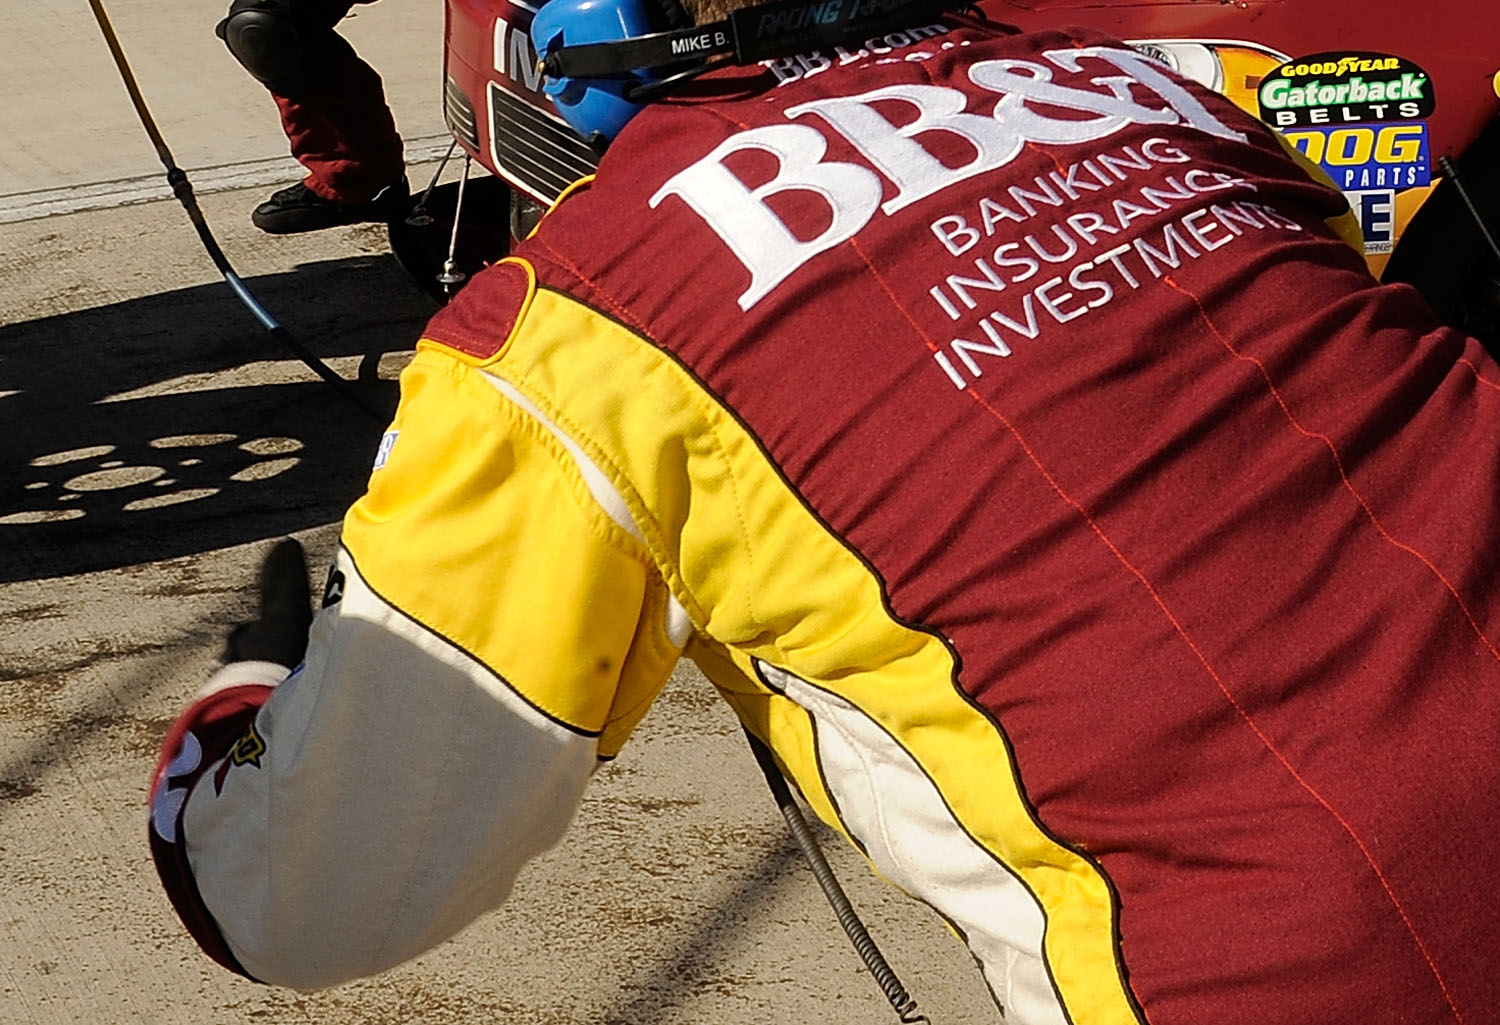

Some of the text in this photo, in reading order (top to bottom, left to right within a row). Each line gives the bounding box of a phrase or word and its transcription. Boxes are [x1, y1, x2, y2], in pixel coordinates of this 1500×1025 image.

[671, 30, 730, 55] MIKE B.
[1260, 73, 1427, 109] Gatorback
[1276, 102, 1421, 126] BELTS
[649, 46, 1248, 312] BB&T
[930, 137, 1192, 257] BANKING
[1345, 166, 1417, 187] PARTS
[929, 169, 1258, 321] INSURANCE
[933, 200, 1303, 391] INVESTMENTS
